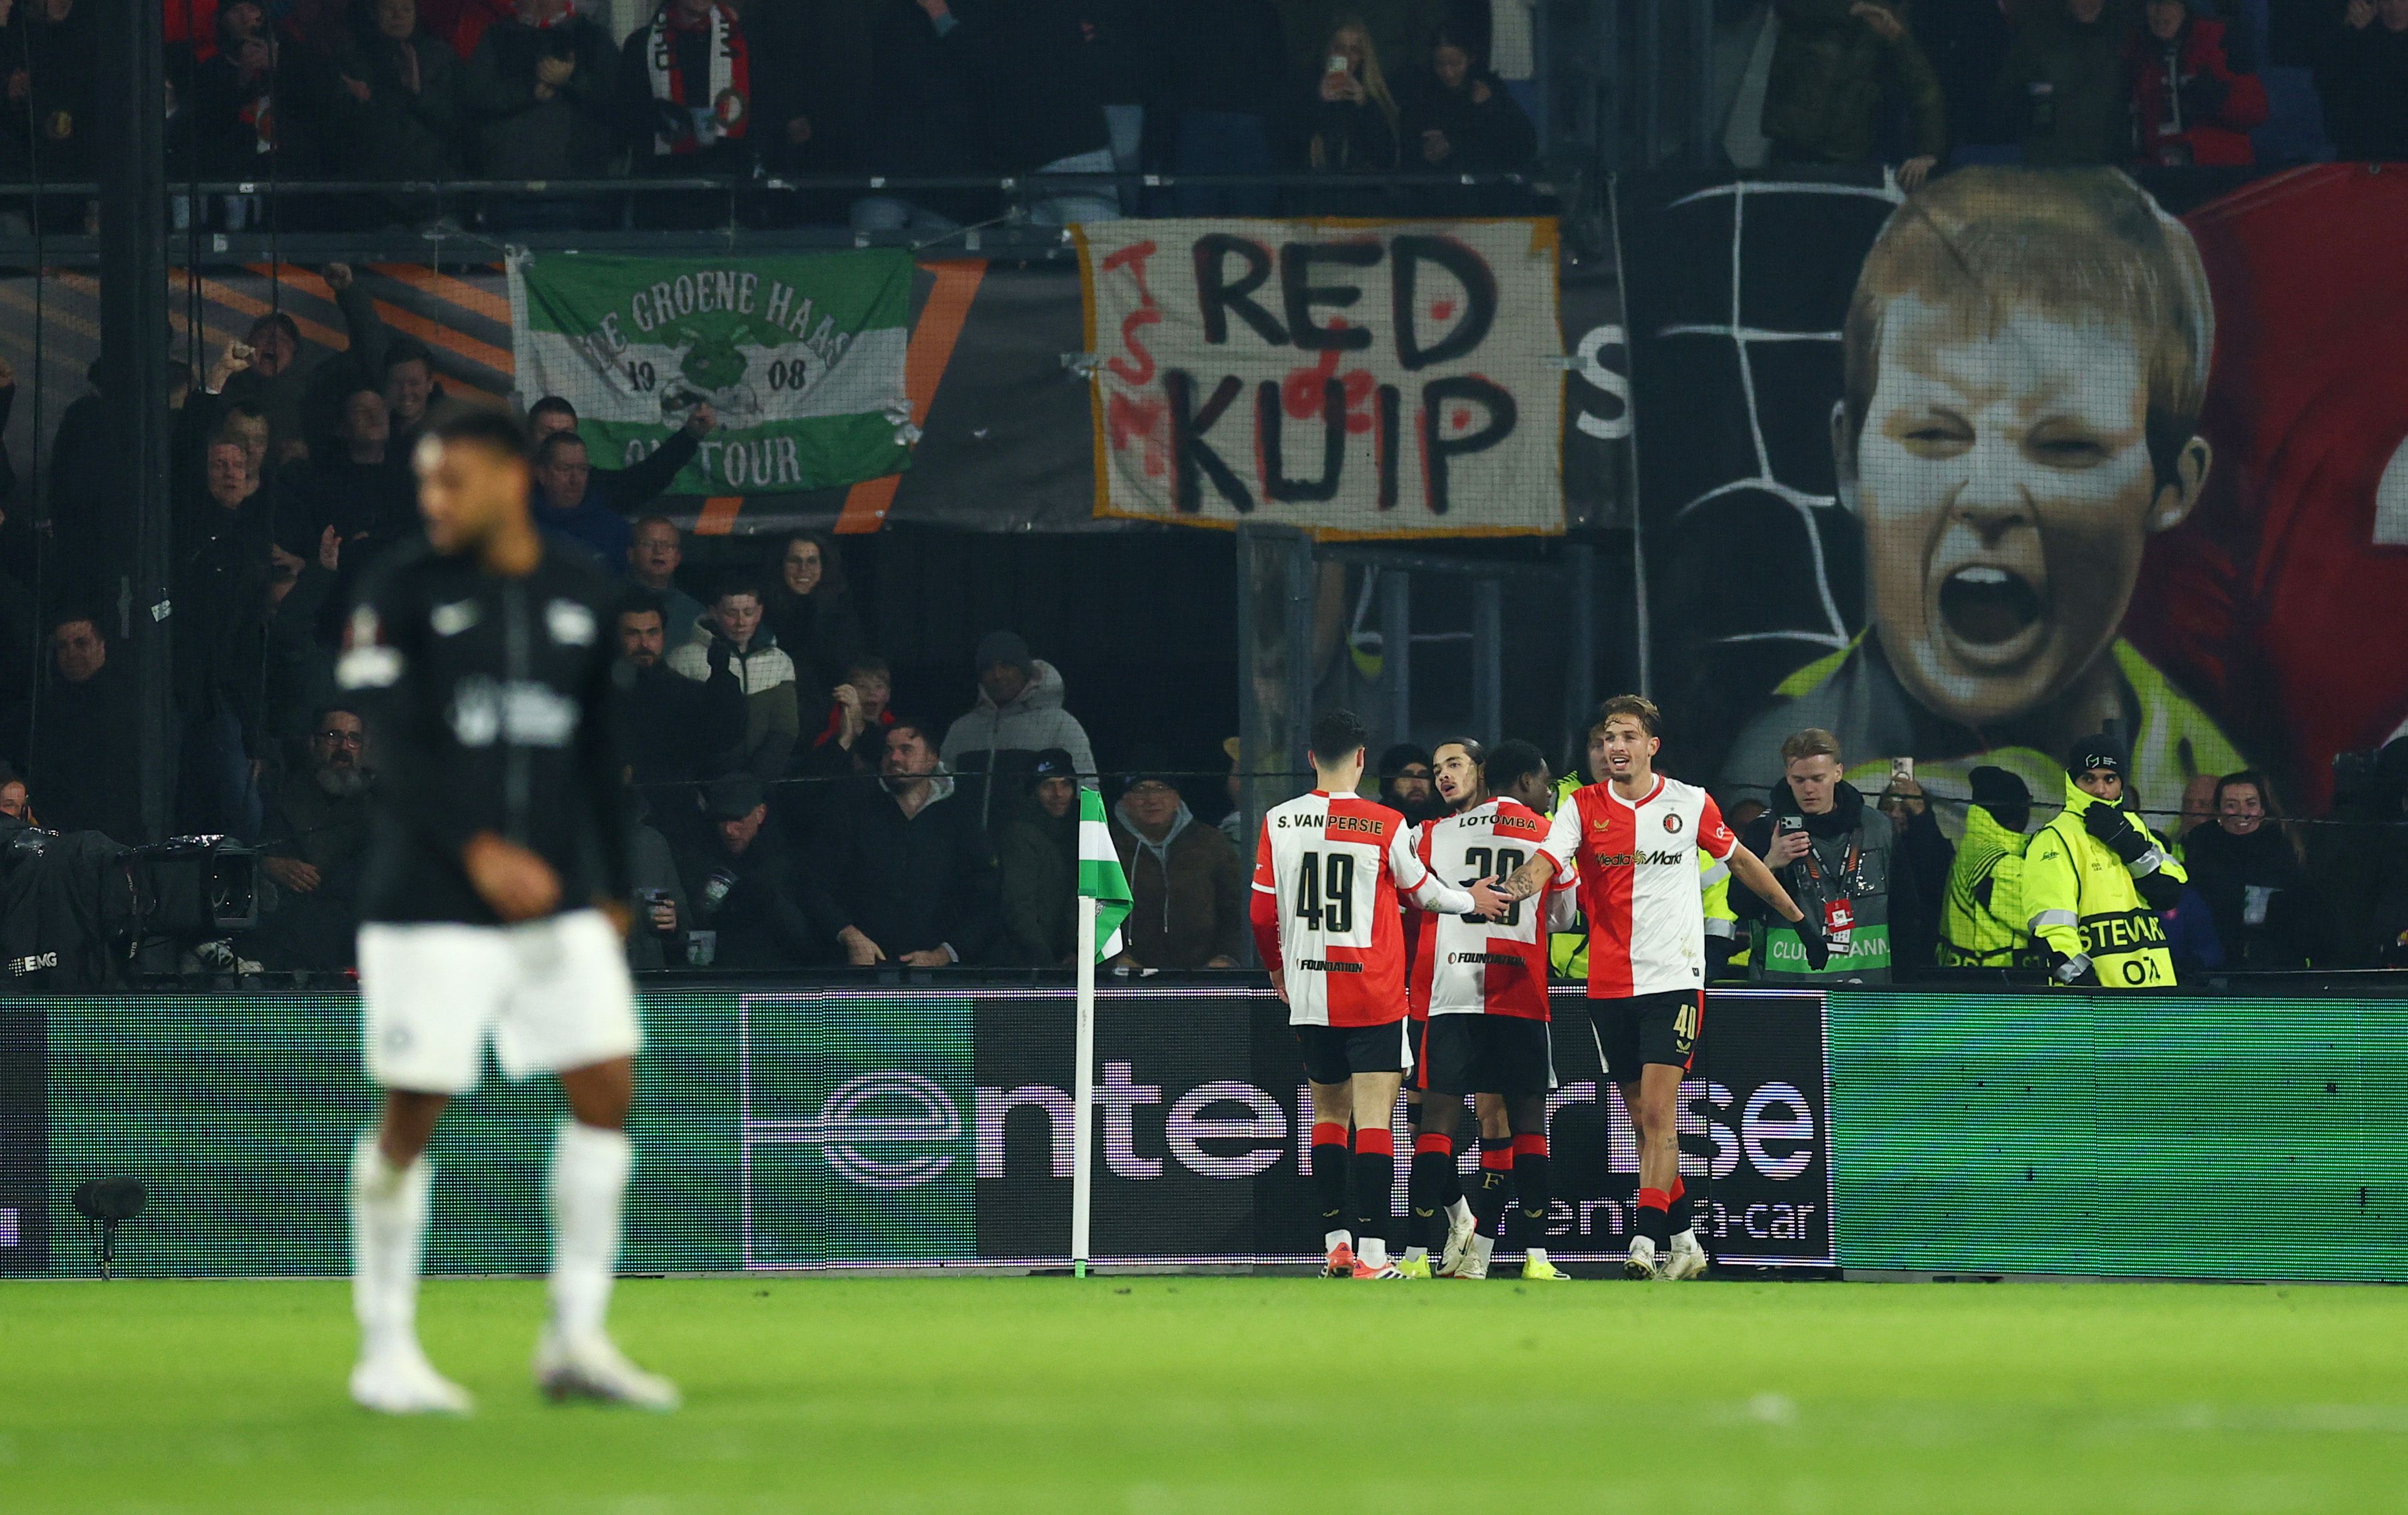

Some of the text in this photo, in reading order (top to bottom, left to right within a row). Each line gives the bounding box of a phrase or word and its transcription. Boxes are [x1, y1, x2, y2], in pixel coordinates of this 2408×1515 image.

[631, 270, 758, 332] GROENE
[1192, 233, 1498, 371] RED
[627, 361, 656, 393] 19
[768, 358, 807, 391] 08
[1163, 368, 1518, 515] KUIP
[698, 436, 801, 488] TOUR
[1278, 814, 1384, 835] S. VAN PERSIE
[1458, 814, 1538, 833] LOTOMBA
[1296, 851, 1354, 933] 49
[24, 952, 58, 972] EMG
[1673, 1004, 1697, 1040] 40
[1482, 1173, 1504, 1189] F
